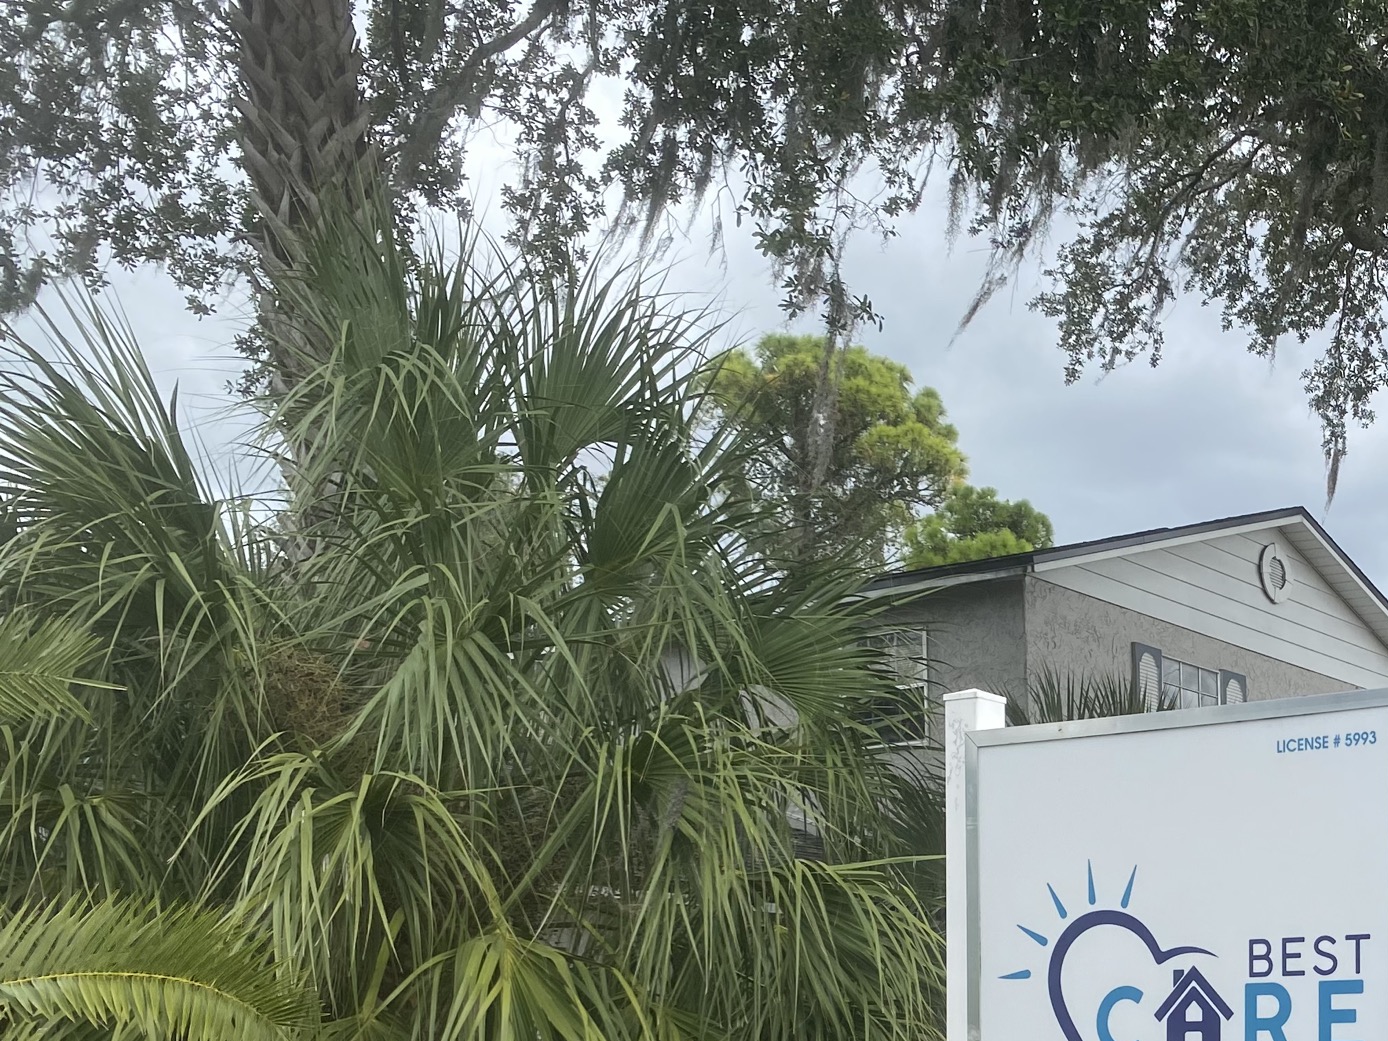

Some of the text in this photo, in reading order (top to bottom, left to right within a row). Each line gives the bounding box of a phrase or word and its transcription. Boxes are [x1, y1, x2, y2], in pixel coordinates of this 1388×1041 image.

[1276, 730, 1377, 754] LICENSE # 5993
[1249, 934, 1370, 977] BEST
